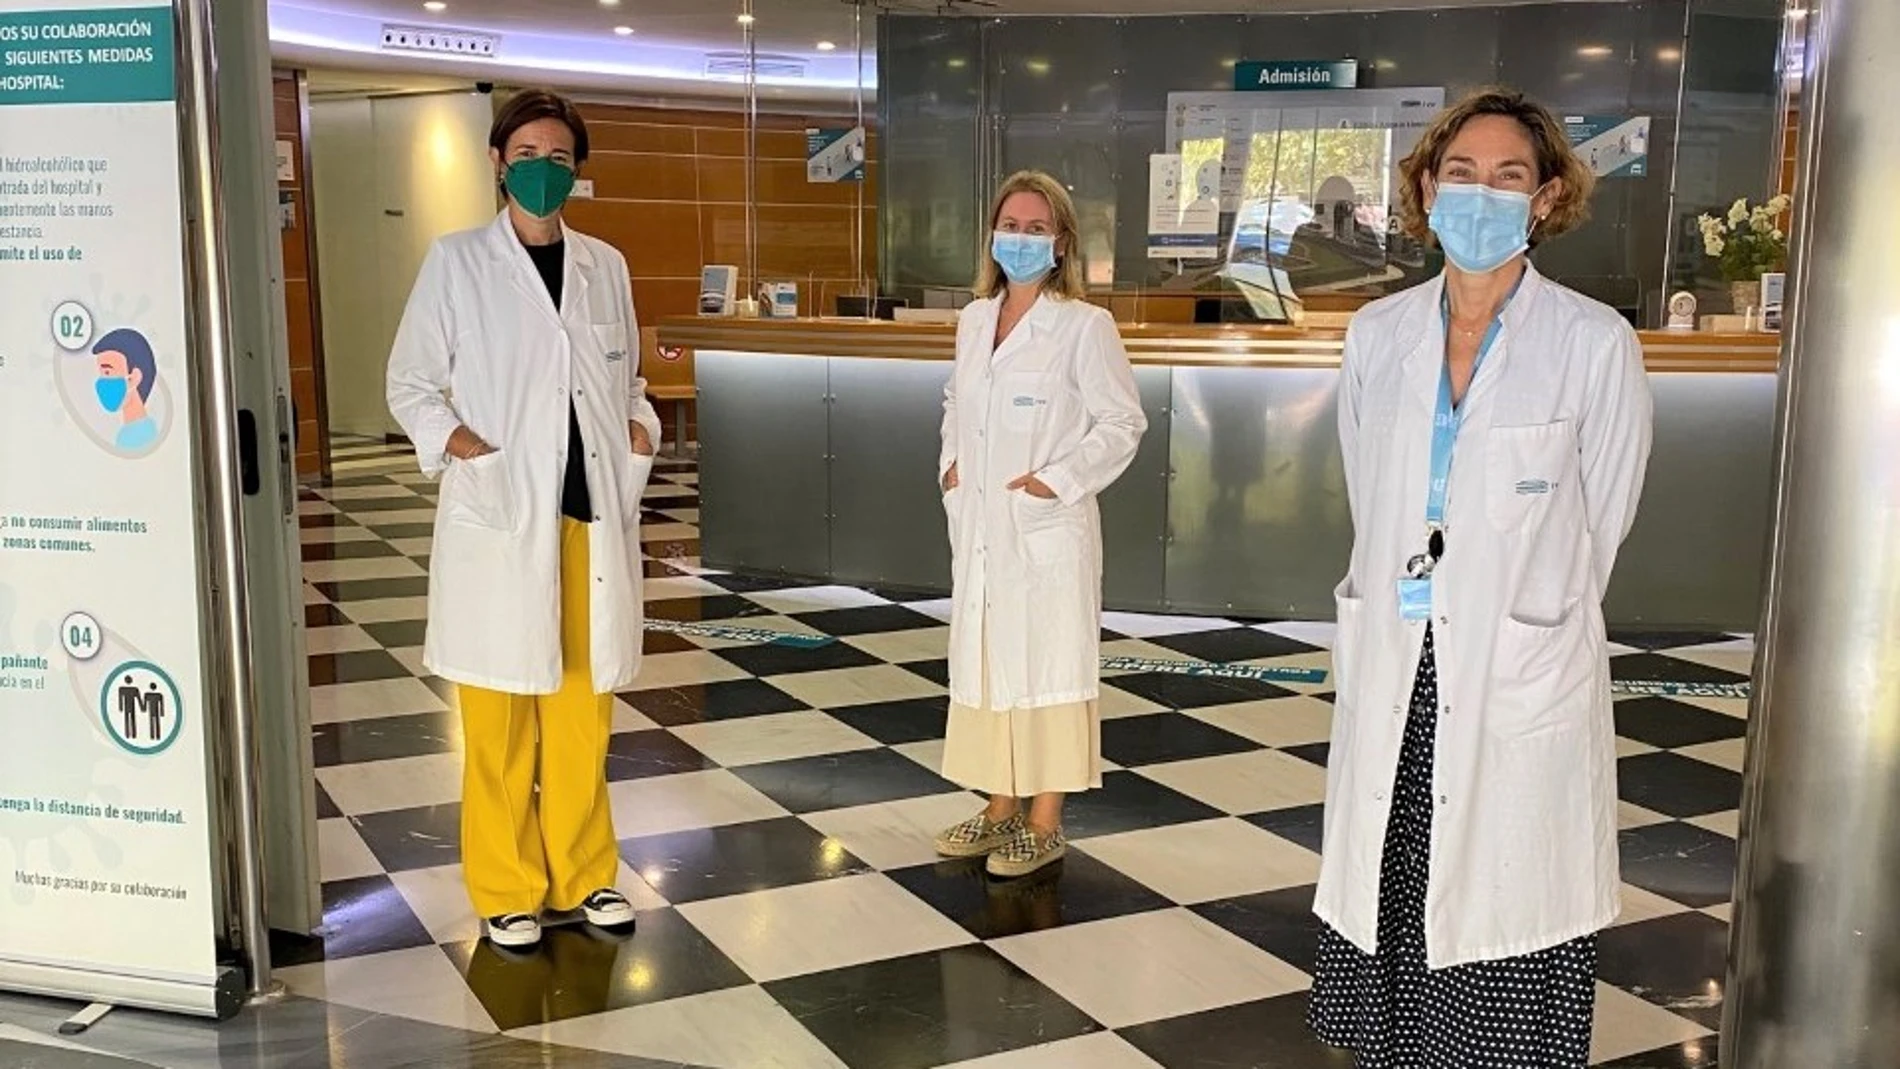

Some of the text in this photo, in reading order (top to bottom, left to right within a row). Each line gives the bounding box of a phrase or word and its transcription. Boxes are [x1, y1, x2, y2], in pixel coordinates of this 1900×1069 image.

[21, 26, 38, 40] SU
[41, 18, 152, 39] COLABORACIÓN
[5, 47, 153, 66] SIGUIENTES MEDIDAS
[1258, 67, 1330, 84] Admisión
[5, 156, 85, 173] hidroalcohólico
[87, 159, 107, 174] que
[31, 179, 48, 195] del
[50, 179, 93, 197] hospital
[96, 182, 102, 197] y
[59, 202, 76, 216] las
[77, 205, 113, 217] manos
[29, 245, 39, 260] el
[42, 248, 64, 260] uso
[67, 245, 82, 260] de
[60, 315, 84, 337] 02
[11, 516, 26, 528] no
[29, 516, 82, 531] consumir
[86, 517, 147, 533] alimentos
[3, 537, 96, 553] zonas comunes.
[70, 625, 92, 648] 04
[20, 678, 32, 690] en
[35, 676, 45, 690] el
[33, 798, 45, 813] la
[48, 799, 101, 817] distancia
[104, 804, 120, 819] de
[15, 870, 187, 900] Muchas gracias por su colaboración
